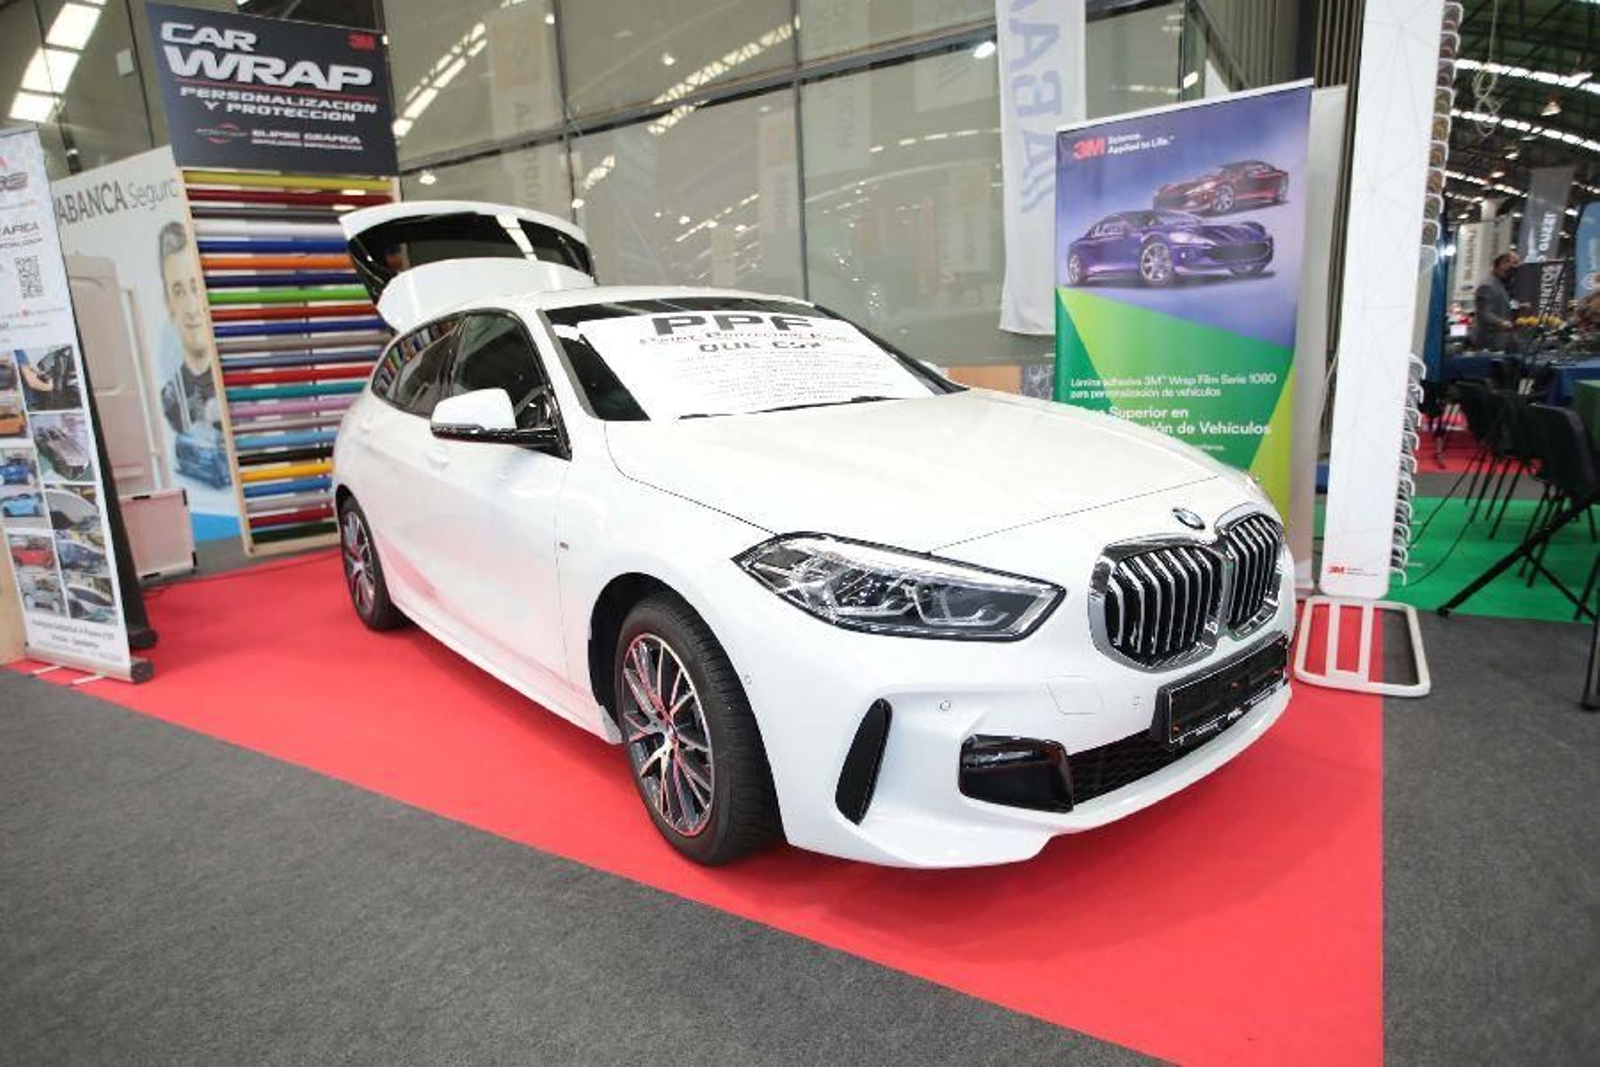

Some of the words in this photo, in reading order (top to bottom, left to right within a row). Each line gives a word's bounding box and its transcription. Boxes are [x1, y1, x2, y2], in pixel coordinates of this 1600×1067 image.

[161, 21, 257, 51] CAR
[163, 46, 373, 91] WRAP
[204, 101, 220, 111] Y
[1073, 137, 1106, 160] 3M
[1108, 143, 1139, 155] Applied
[56, 179, 127, 227] ABANCA
[652, 314, 813, 336] PPF
[1169, 375, 1197, 387] Wrap
[1198, 374, 1219, 385] Film
[1221, 373, 1247, 385] Serie
[1250, 372, 1277, 384] 1080
[1161, 388, 1174, 397] de
[1109, 406, 1167, 420] Superior
[1171, 409, 1189, 418] en
[1177, 422, 1195, 434] de
[1329, 566, 1345, 575] 3M
